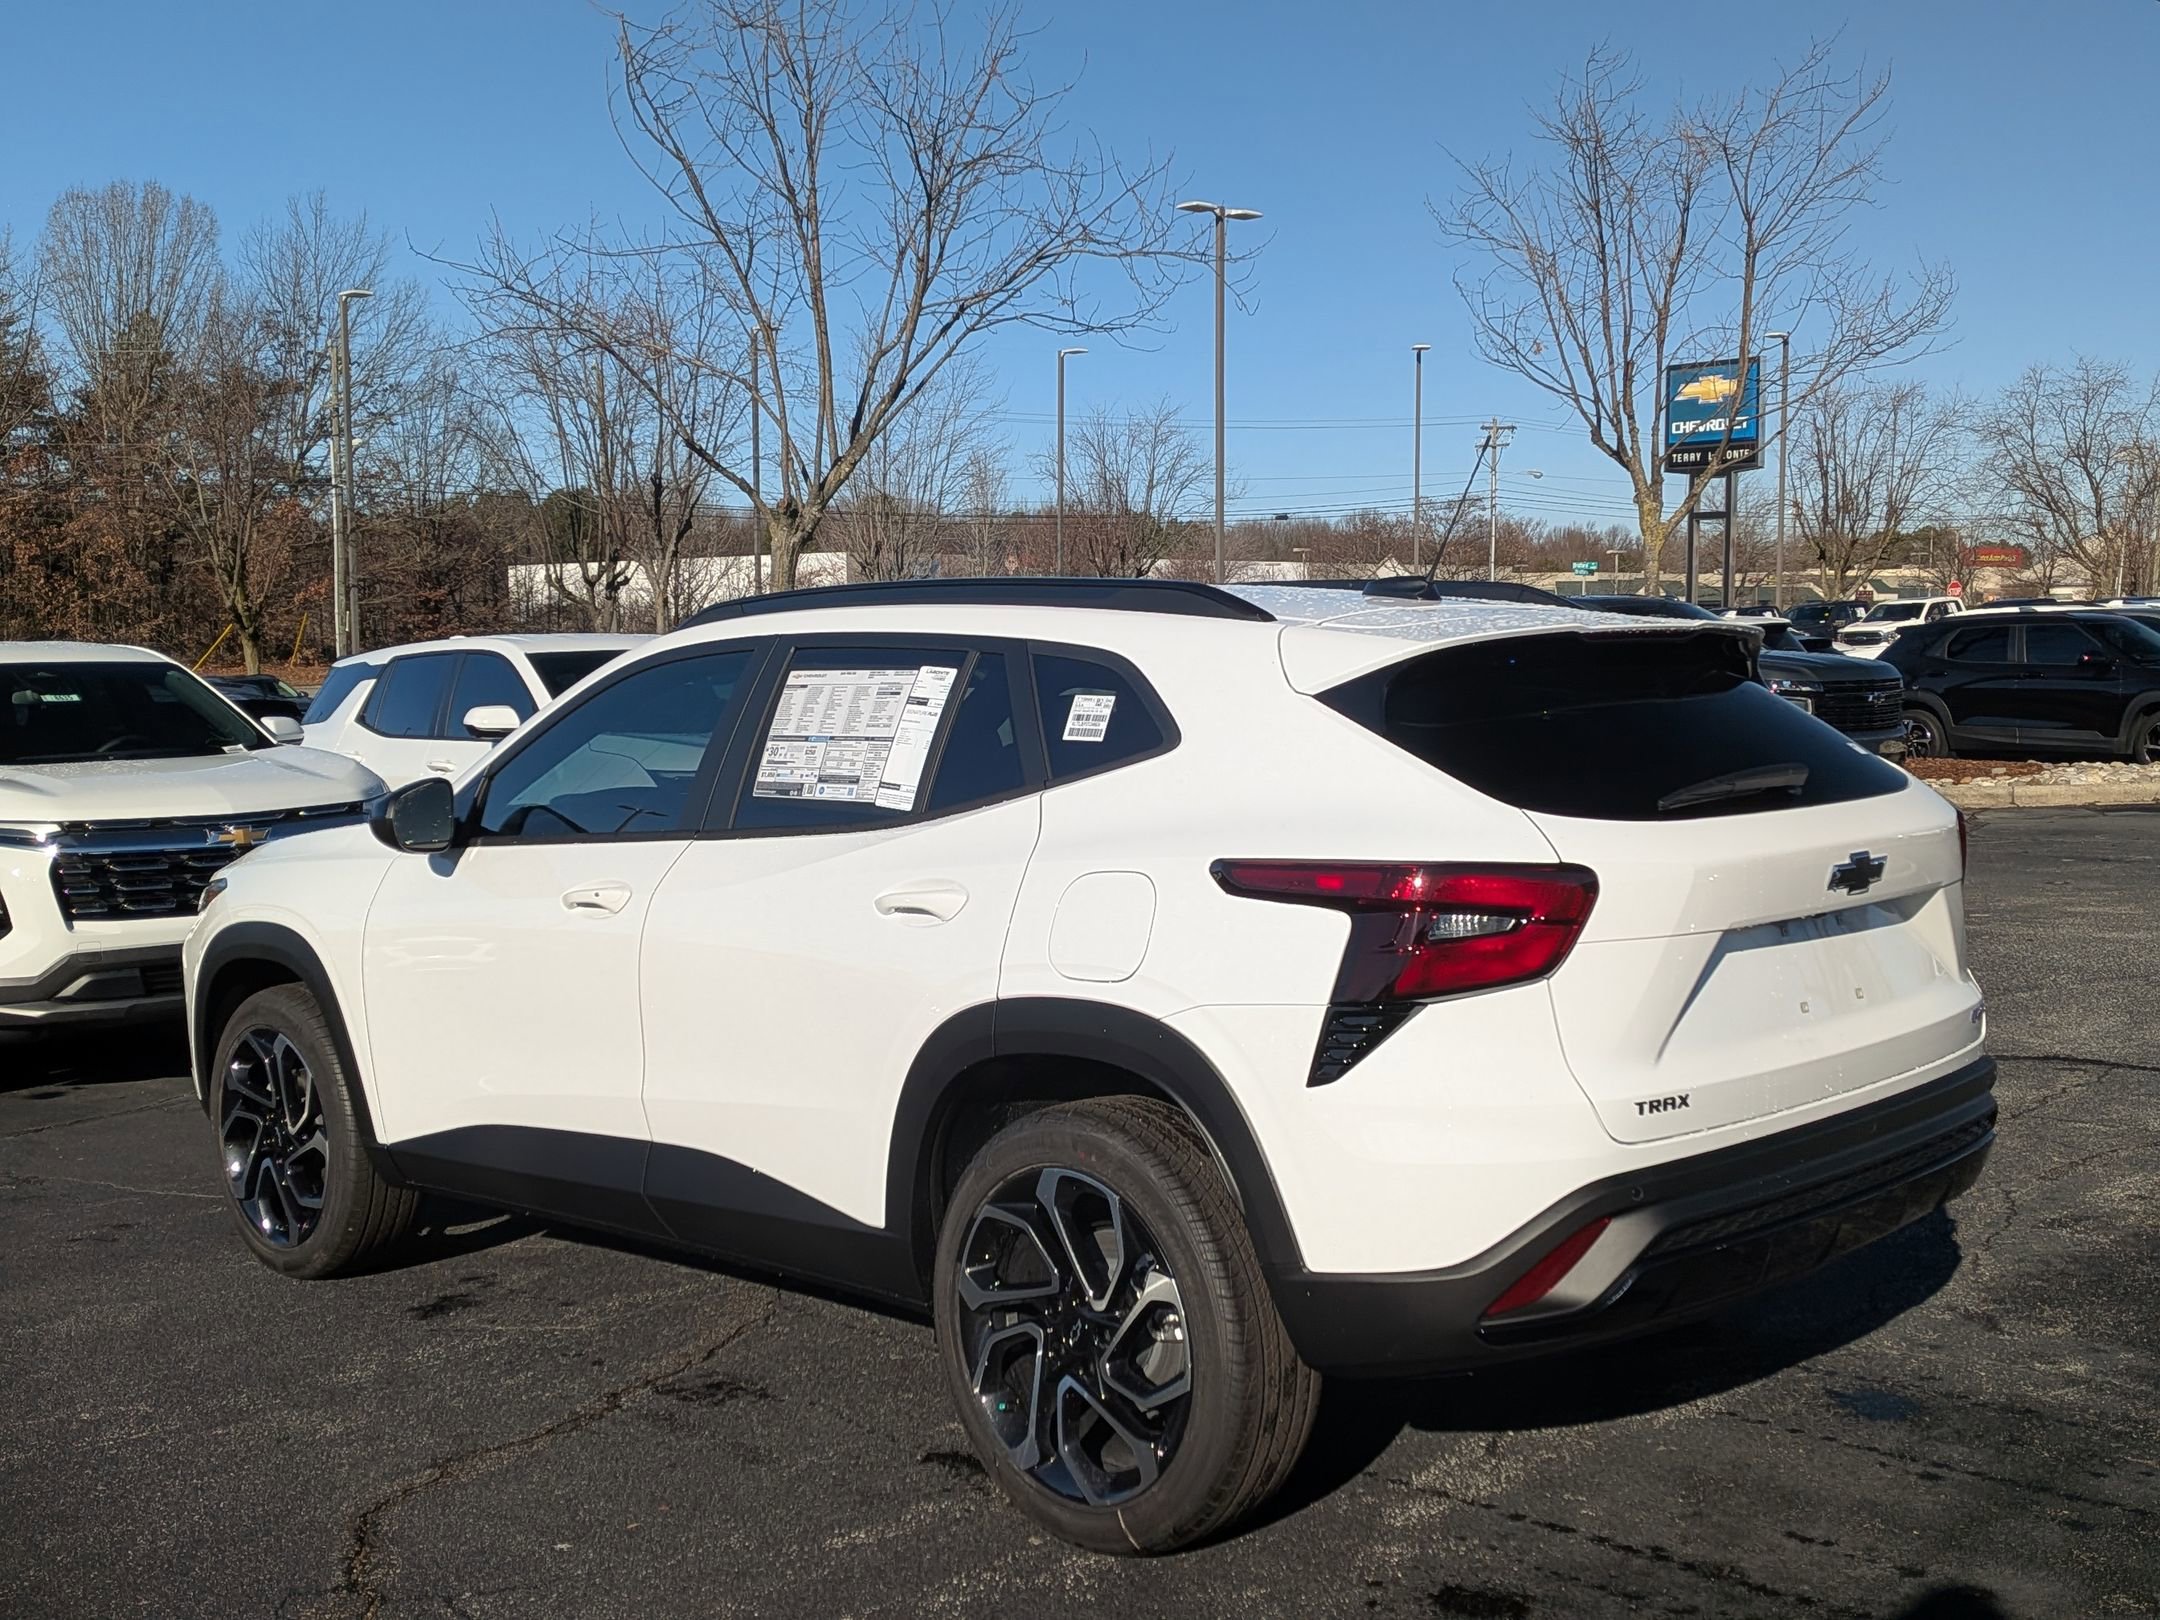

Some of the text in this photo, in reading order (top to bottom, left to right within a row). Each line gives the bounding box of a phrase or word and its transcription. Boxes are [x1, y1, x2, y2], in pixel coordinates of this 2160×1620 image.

[1672, 449, 1750, 463] TERRY LONTE
[1633, 1094, 1690, 1115] TRAX
